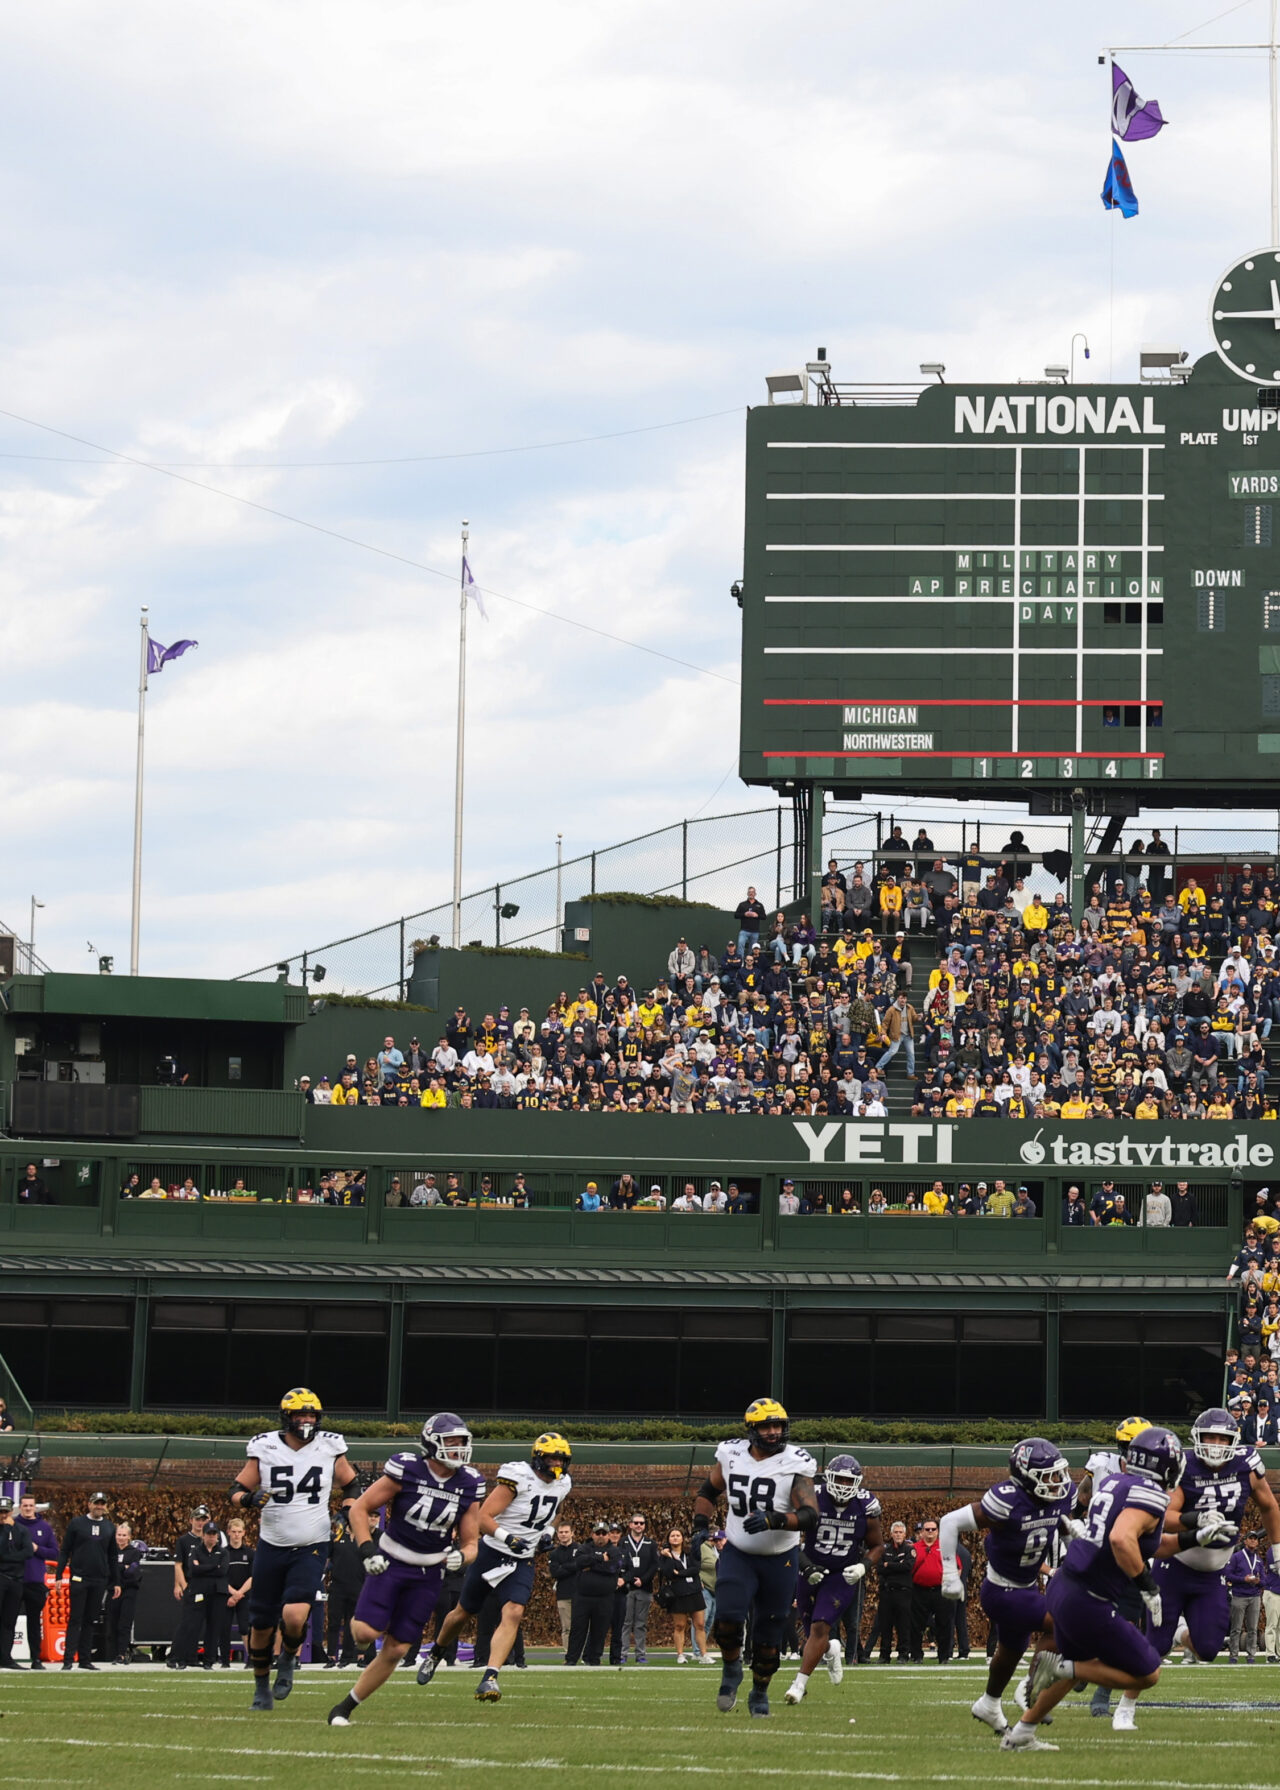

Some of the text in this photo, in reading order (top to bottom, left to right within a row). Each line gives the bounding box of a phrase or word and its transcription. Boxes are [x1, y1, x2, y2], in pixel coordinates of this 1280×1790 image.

[955, 396, 1165, 434] NATIONAL
[1180, 432, 1218, 445] PLATE
[1242, 432, 1259, 445] 1ST
[1231, 476, 1278, 494] YARDS
[1194, 570, 1241, 587] DOWN
[1022, 605, 1074, 621] DAY
[844, 707, 917, 724] MICHIGAN
[843, 733, 933, 750] NORTHWESTERN
[979, 758, 1159, 778] 1 2 3 4 F
[625, 1043, 637, 1056] 10
[524, 1096, 539, 1108] 10
[792, 1122, 953, 1164] YETI
[271, 1465, 323, 1505] 54
[726, 1473, 777, 1518] 58
[404, 1494, 460, 1538] 44
[519, 1495, 559, 1531] 17
[814, 1525, 855, 1557] 95
[1020, 1527, 1049, 1568] 9
